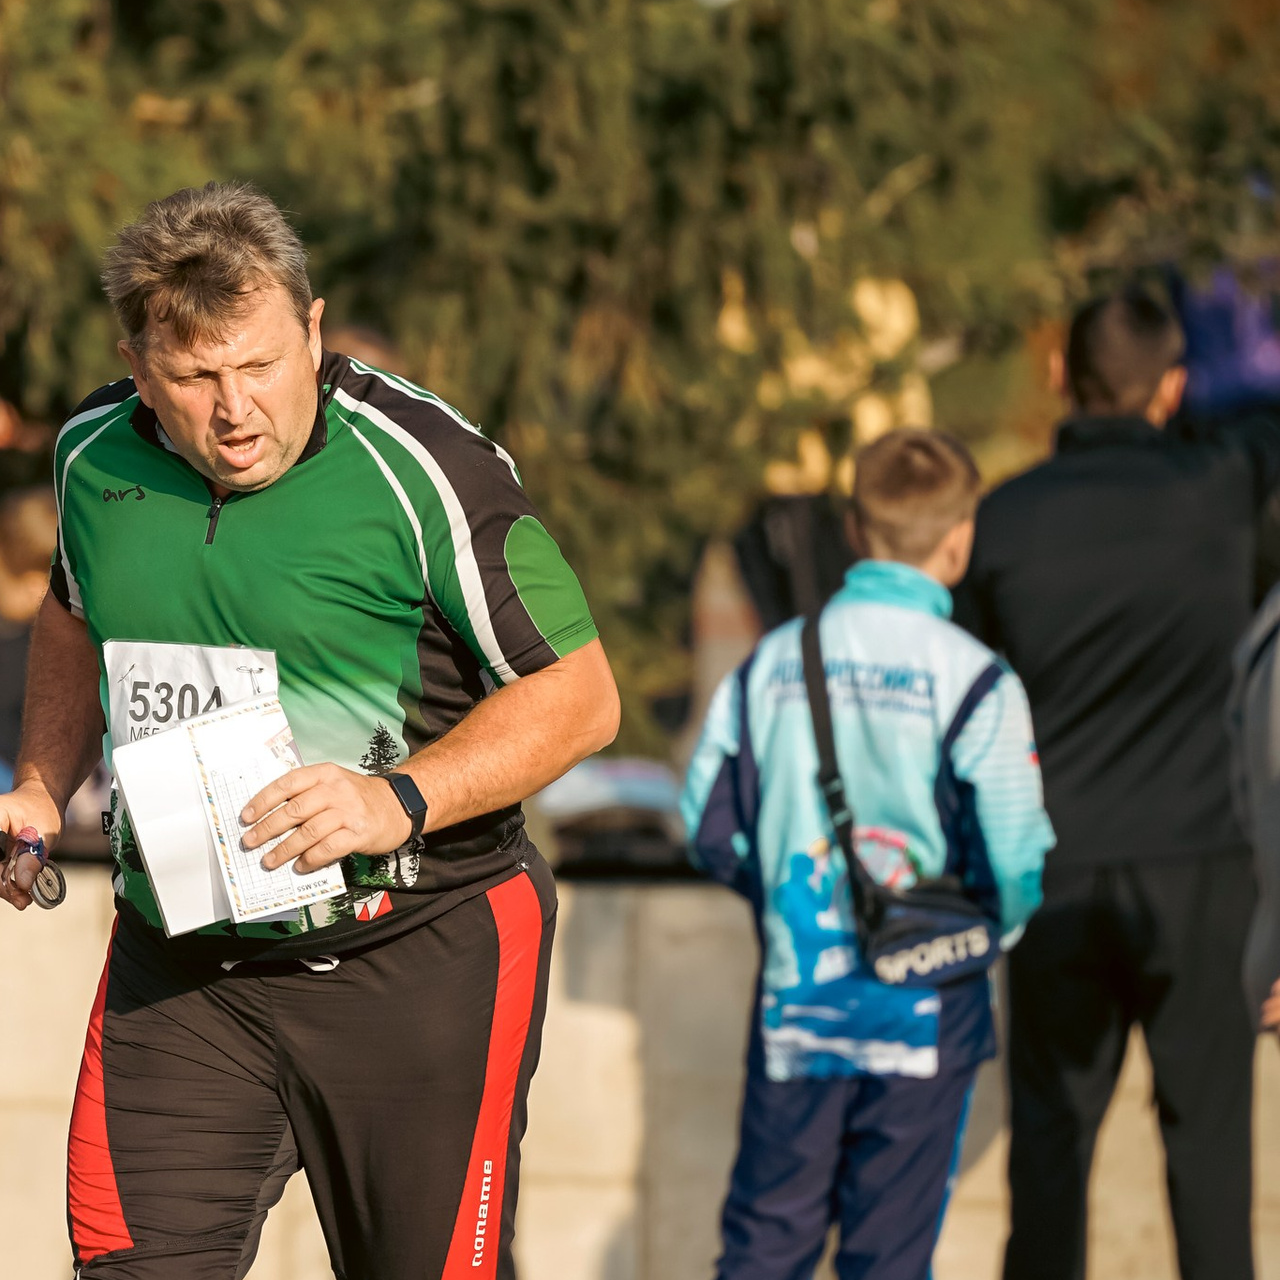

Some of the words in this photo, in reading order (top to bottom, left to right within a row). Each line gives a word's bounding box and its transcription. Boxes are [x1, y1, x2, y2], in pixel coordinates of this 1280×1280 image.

[103, 484, 146, 502] ars
[874, 925, 990, 984] SPORTS
[472, 1160, 493, 1267] noname
